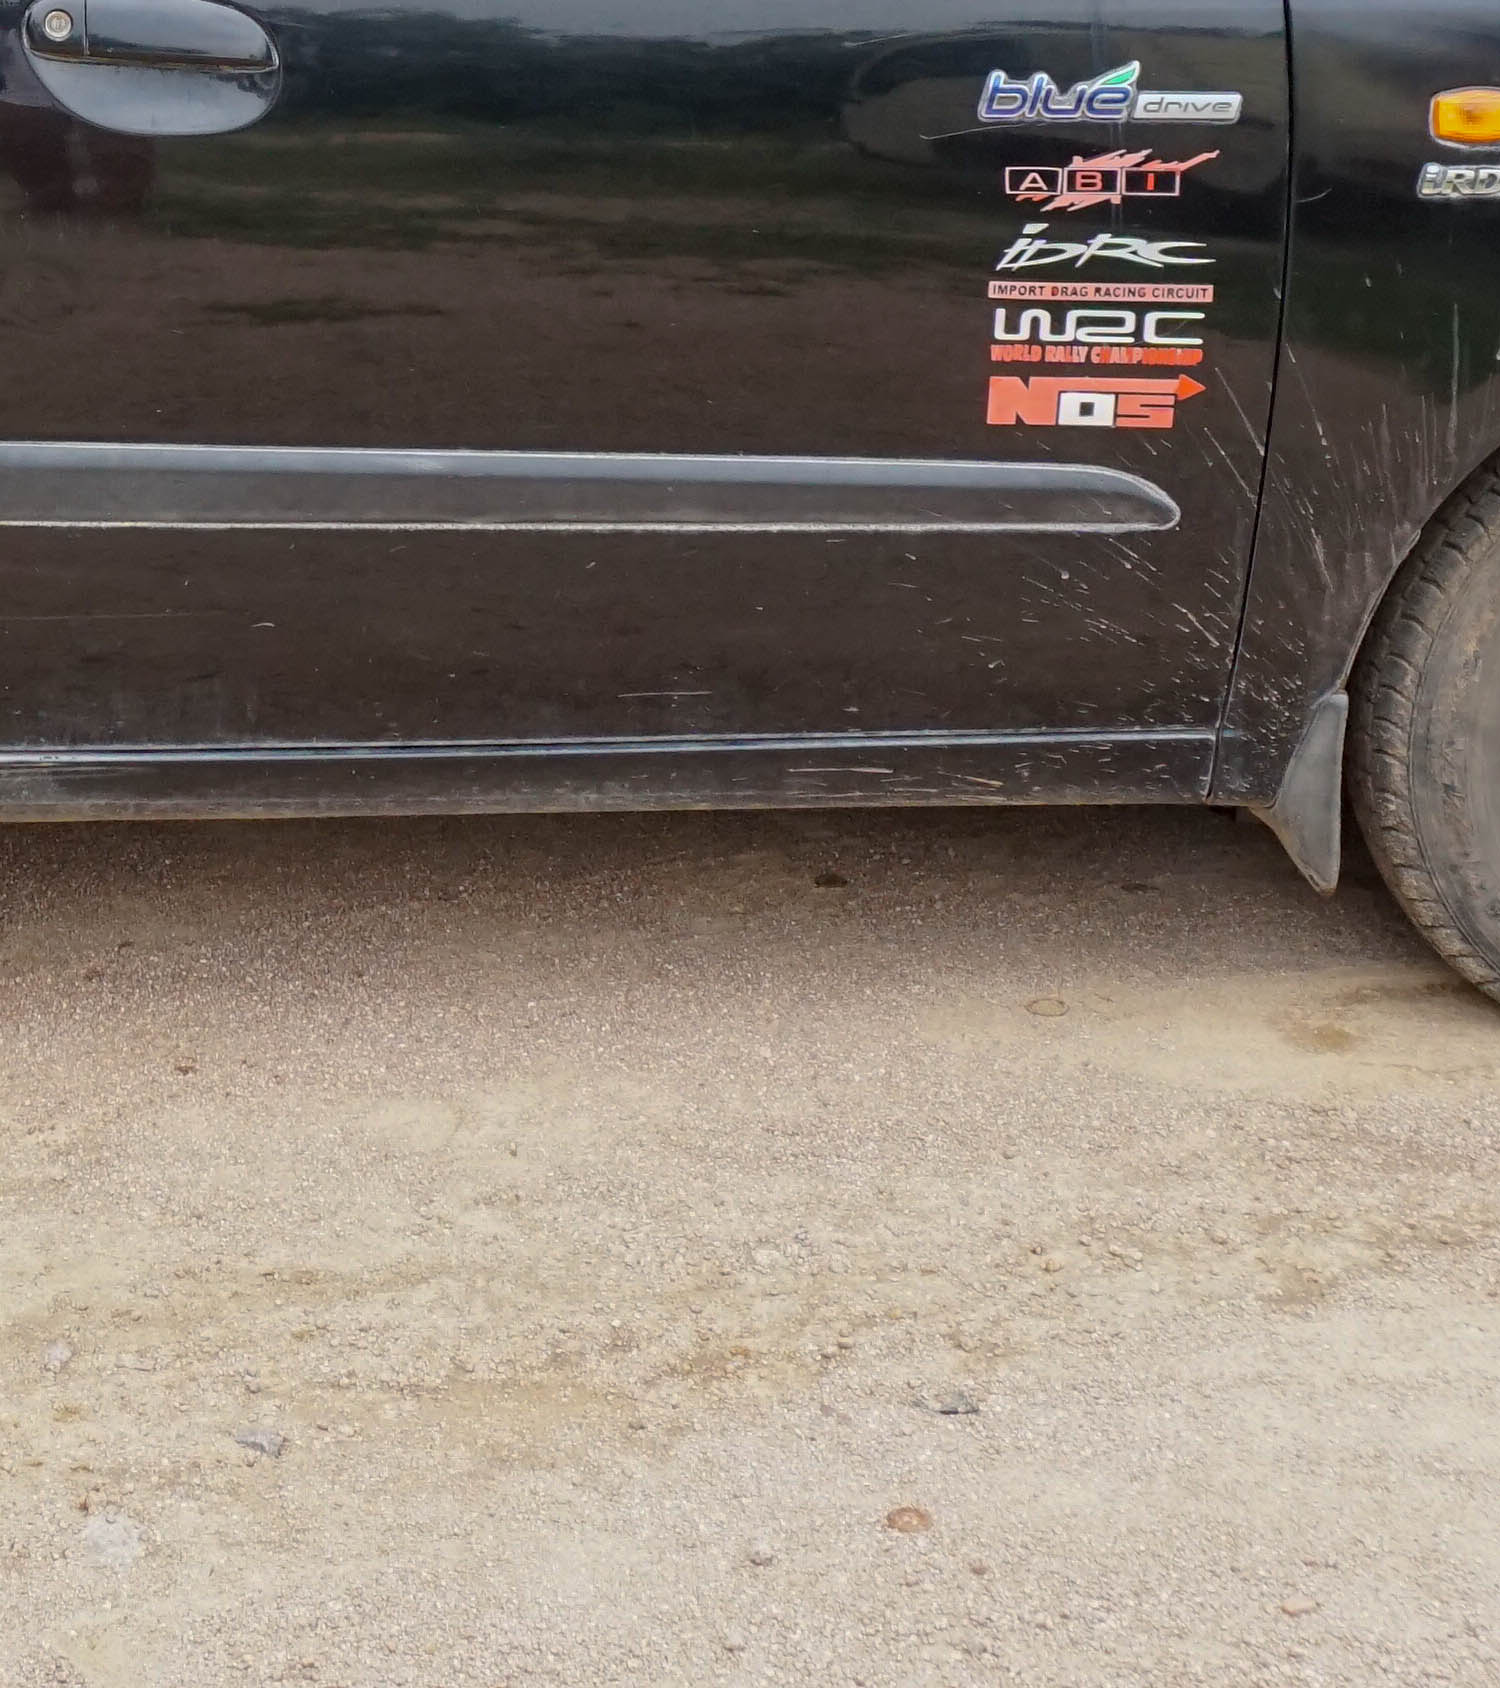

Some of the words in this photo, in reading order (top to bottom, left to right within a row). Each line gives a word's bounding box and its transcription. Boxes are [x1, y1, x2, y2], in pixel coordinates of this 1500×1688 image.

[980, 67, 1135, 120] blue
[992, 284, 1046, 297] IMPORT
[1050, 286, 1089, 298] DRAG
[1093, 286, 1147, 299] RACING
[1151, 286, 1210, 300] CIRCUIT
[993, 307, 1206, 346] WRC
[990, 344, 1043, 362] WORLD
[1044, 345, 1089, 363] RALLY
[986, 375, 1180, 429] NOS
